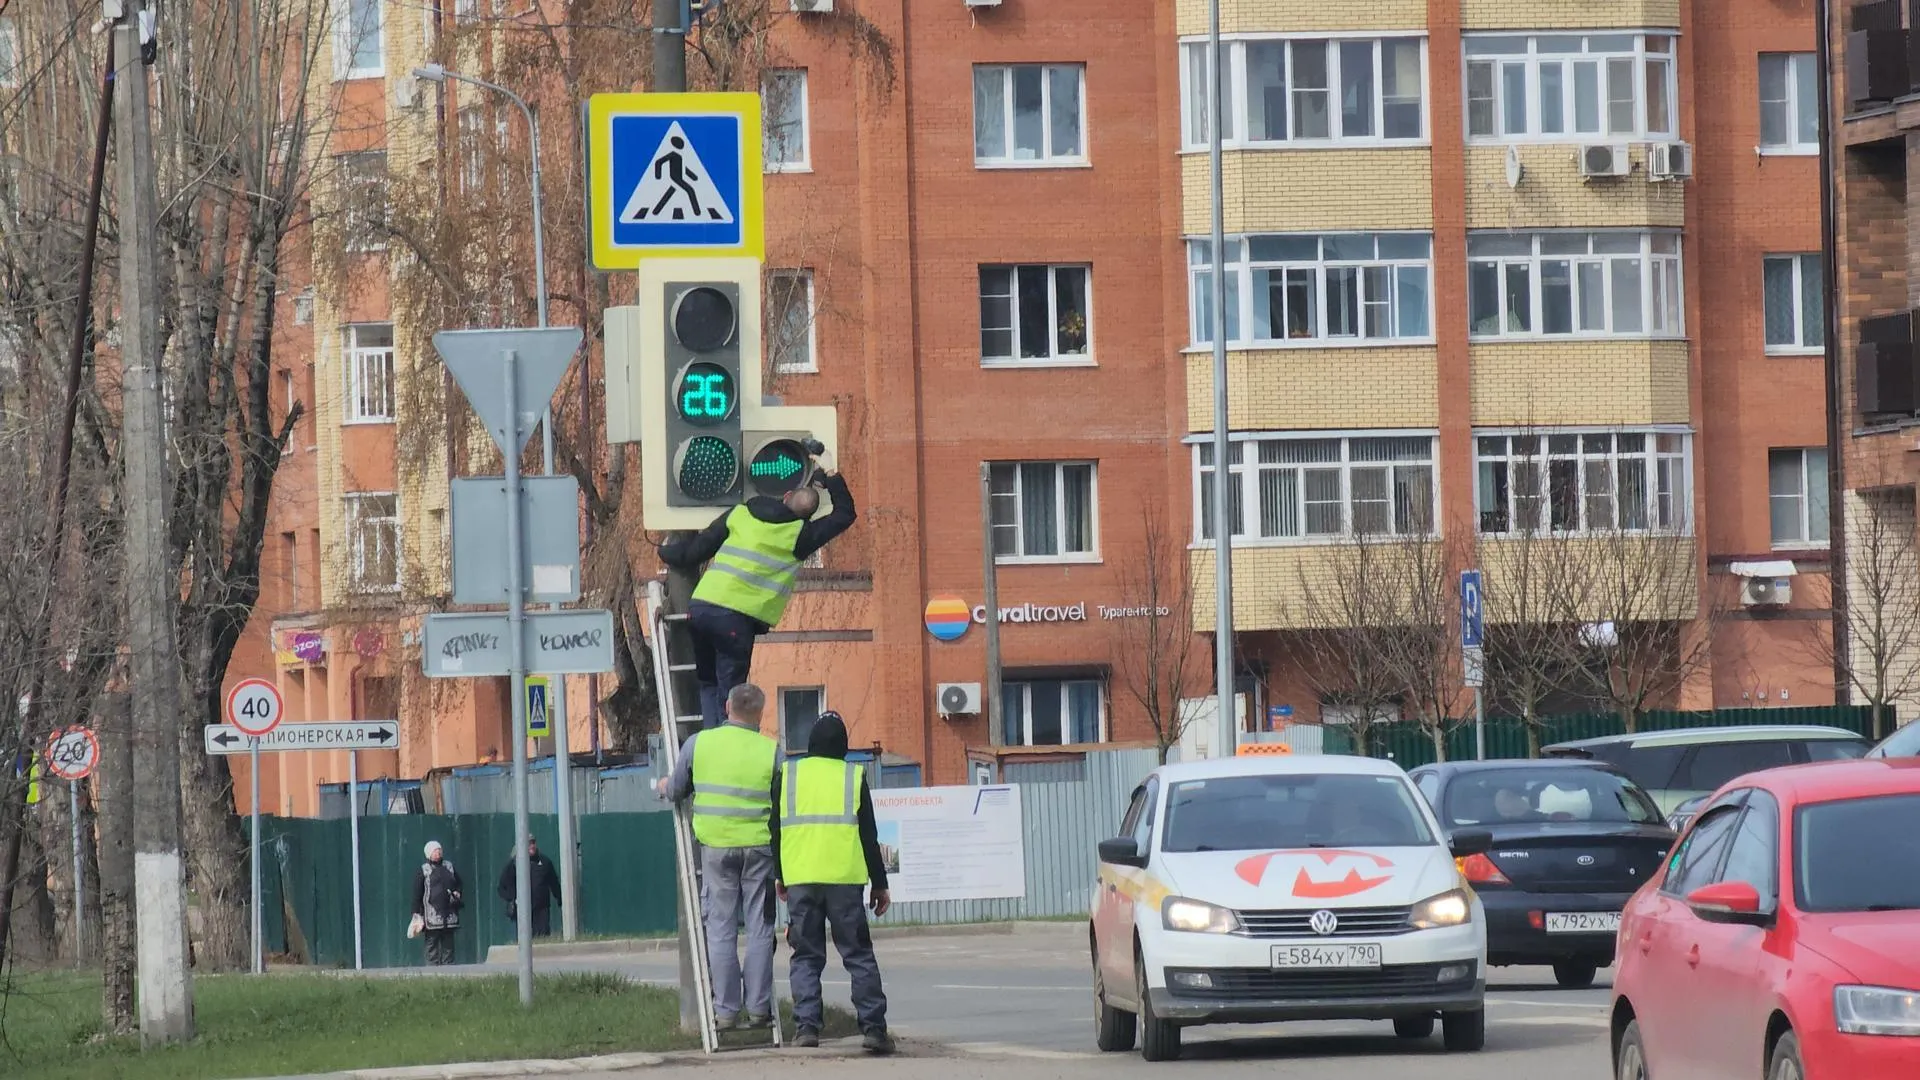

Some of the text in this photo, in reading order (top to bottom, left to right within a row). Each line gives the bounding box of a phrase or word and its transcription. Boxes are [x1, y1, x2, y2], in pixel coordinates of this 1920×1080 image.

[684, 374, 727, 416] 26
[241, 697, 270, 719] 40
[58, 741, 86, 761] 20
[874, 796, 908, 808] ПАСПОРТ
[1349, 946, 1375, 960] 790
